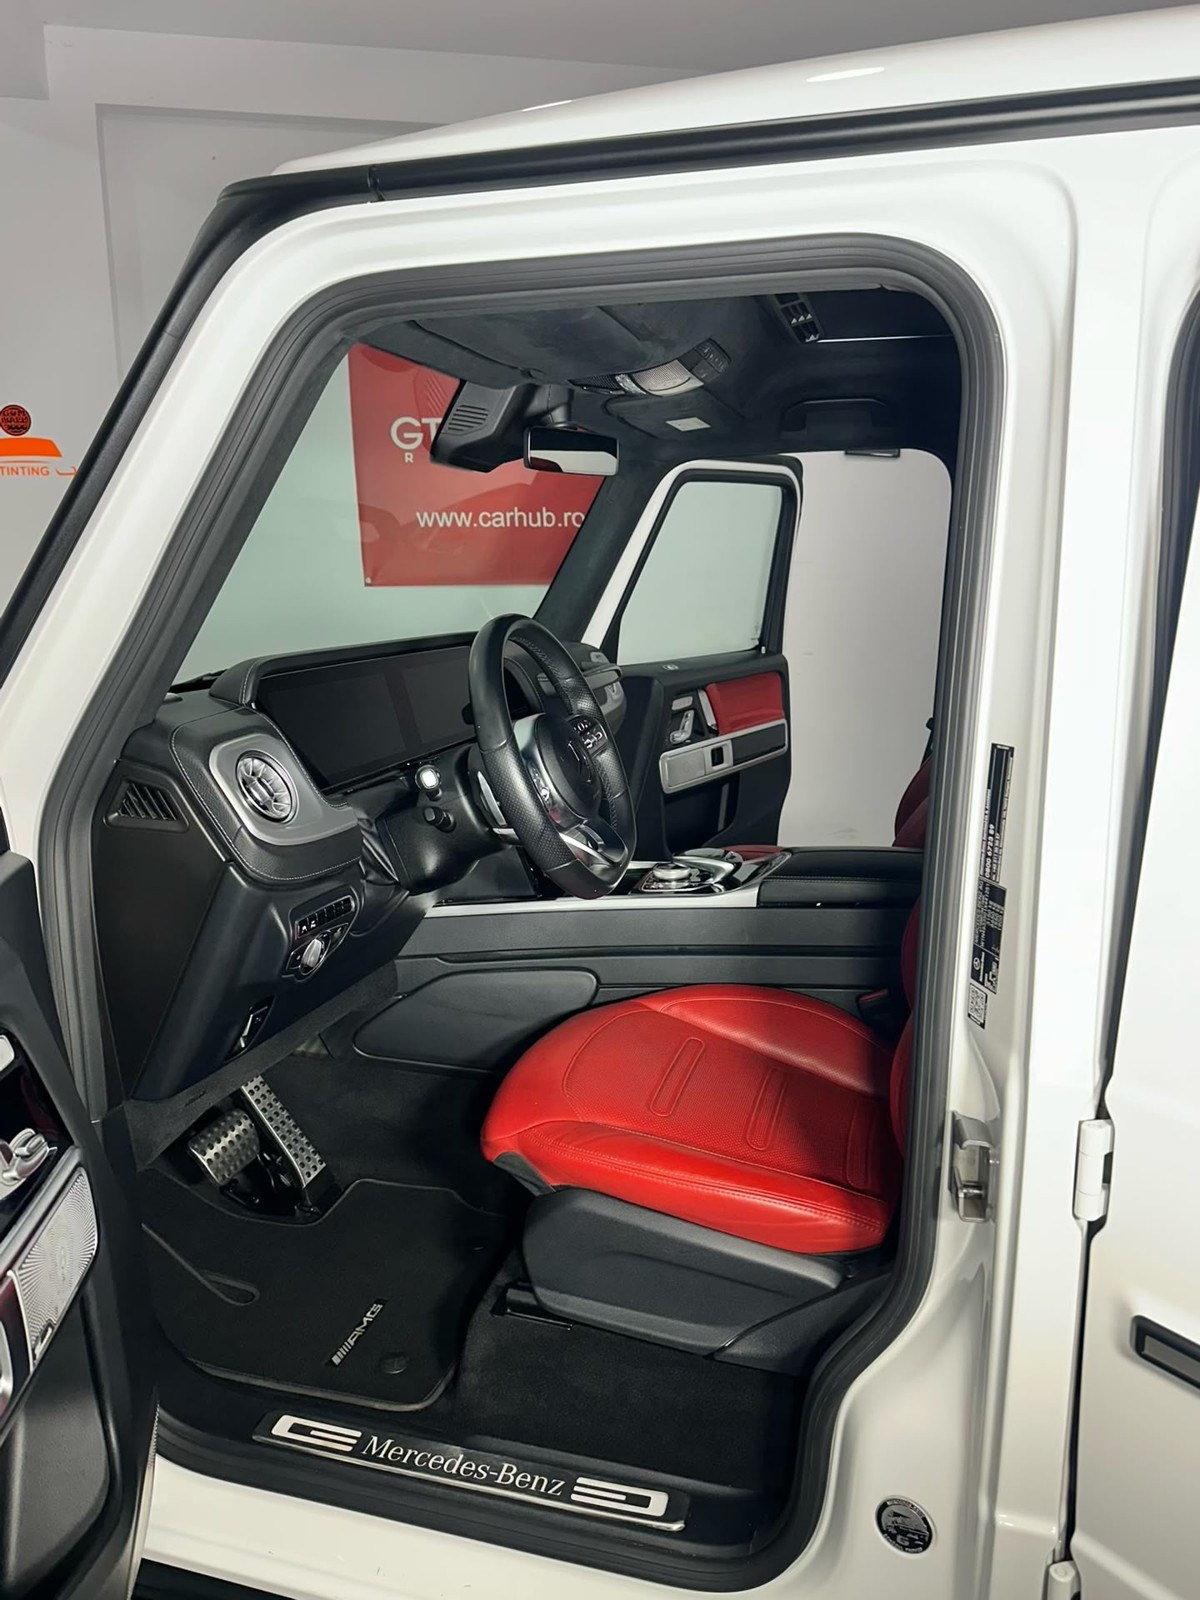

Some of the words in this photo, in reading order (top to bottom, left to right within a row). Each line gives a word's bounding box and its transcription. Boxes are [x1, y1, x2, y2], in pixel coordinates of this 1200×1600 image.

[0, 466, 50, 476] TINTING
[416, 507, 585, 528] www.carhub.ro
[361, 1435, 566, 1496] Mercedes-Benz
